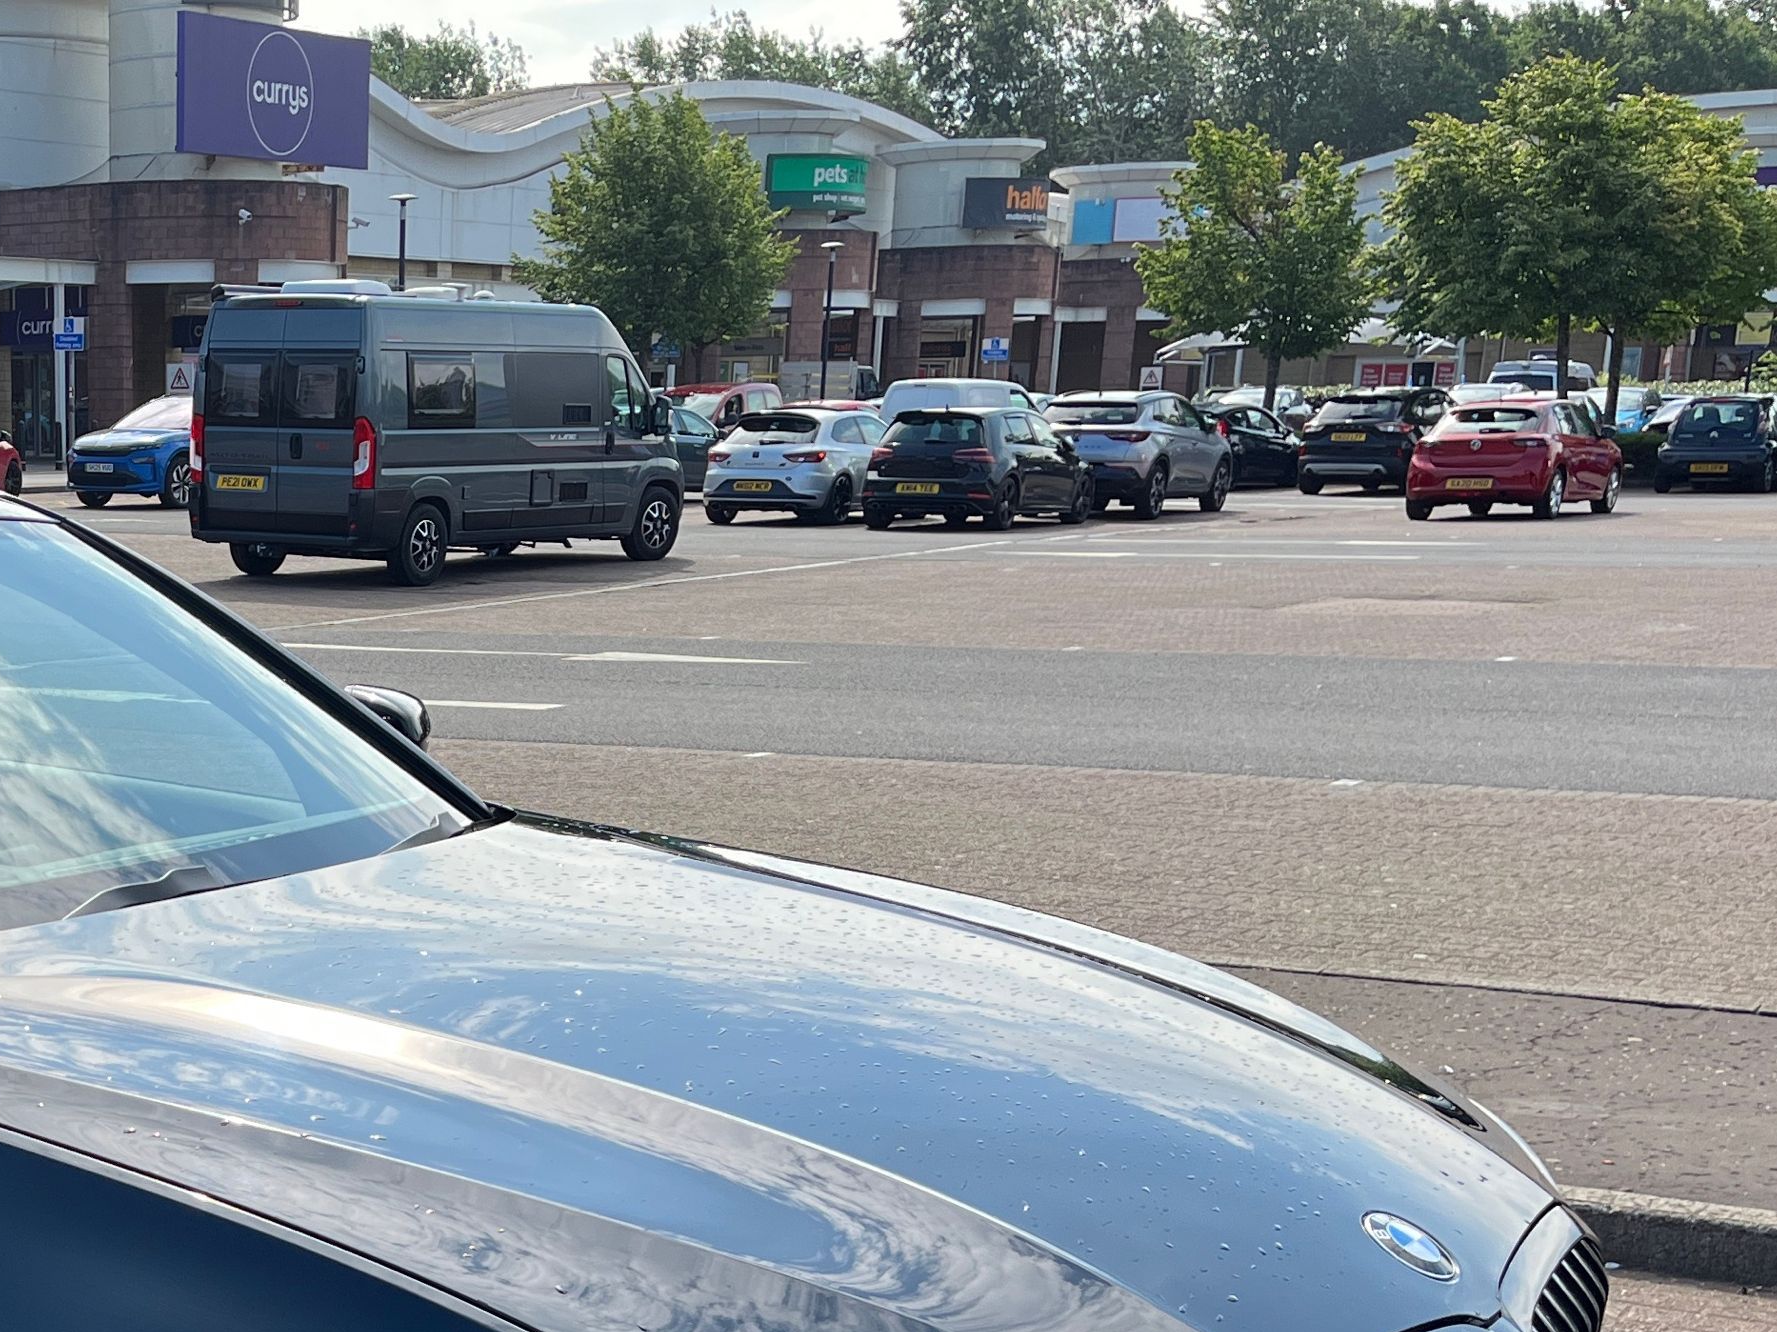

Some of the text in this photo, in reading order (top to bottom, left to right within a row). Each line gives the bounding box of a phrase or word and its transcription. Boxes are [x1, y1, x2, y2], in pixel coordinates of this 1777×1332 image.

[253, 80, 308, 115] currys
[813, 164, 847, 187] pets
[1007, 185, 1047, 210] halfo
[22, 320, 55, 335] curr
[220, 477, 240, 487] PE21
